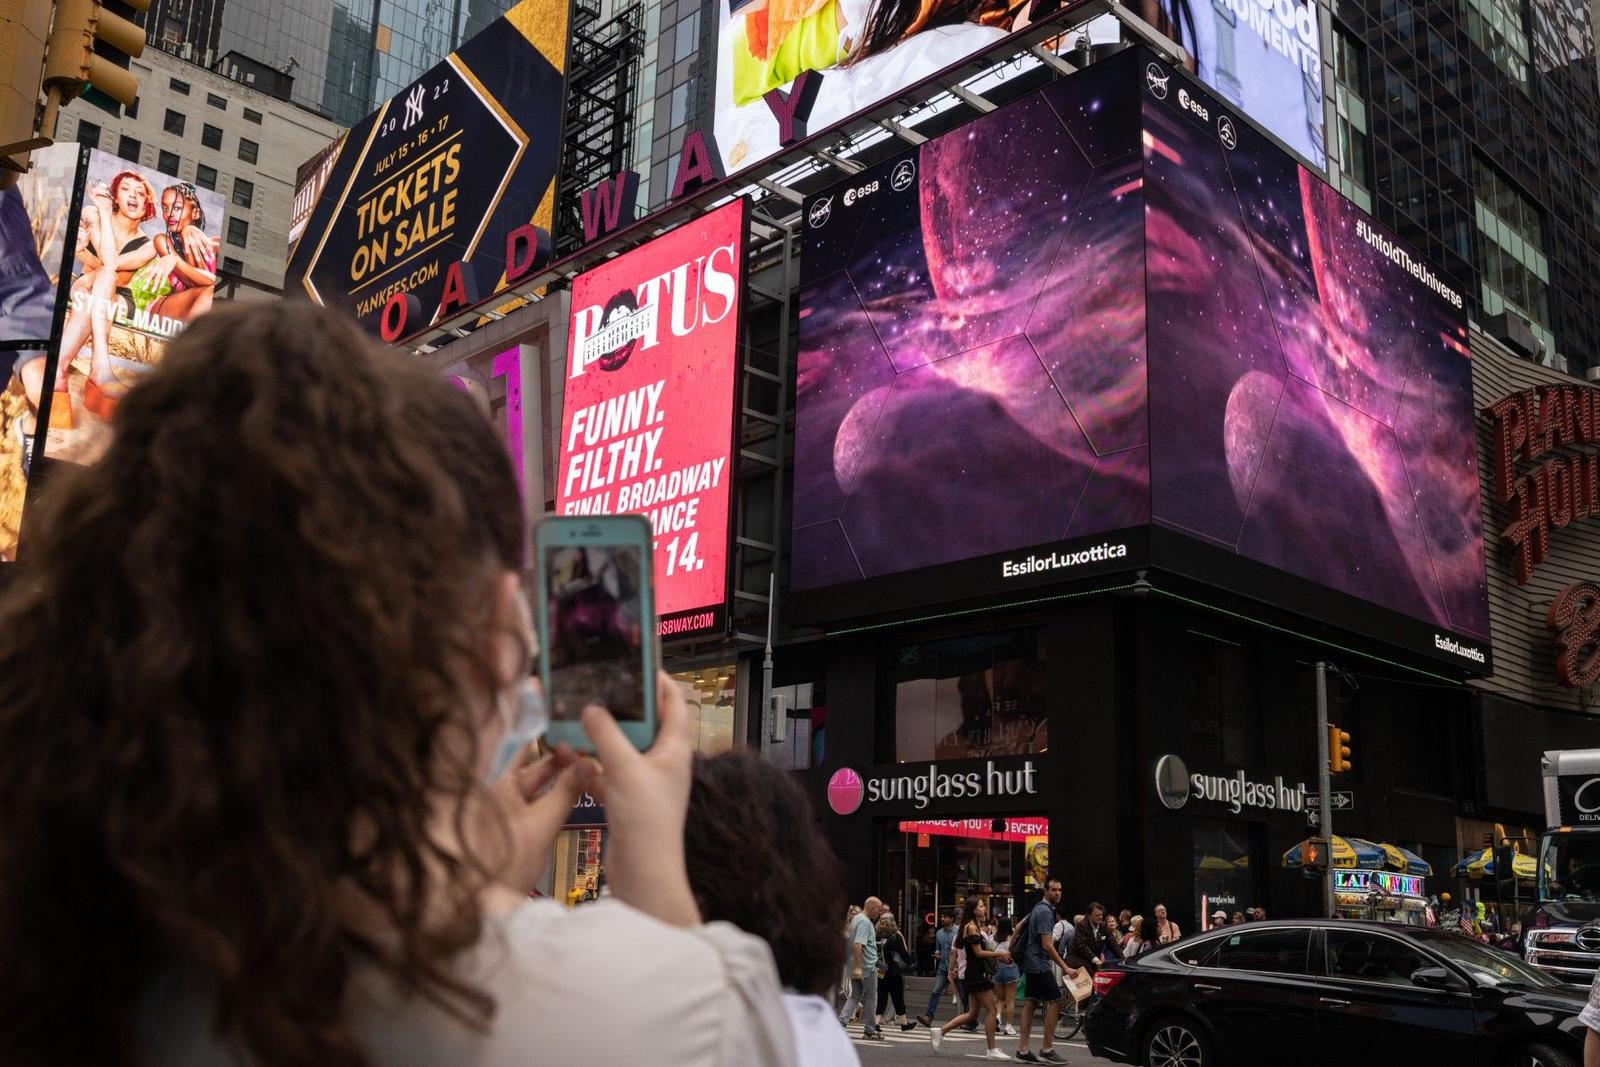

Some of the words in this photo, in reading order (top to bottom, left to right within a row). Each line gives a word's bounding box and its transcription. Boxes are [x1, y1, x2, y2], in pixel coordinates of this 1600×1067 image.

[1222, 0, 1320, 82] OMENT?
[382, 117, 396, 137] 20
[434, 80, 449, 100] 22
[373, 151, 397, 176] JULY
[399, 143, 408, 159] 15
[418, 129, 428, 146] 16
[438, 115, 449, 132] 17
[357, 143, 461, 240] TICKETS
[351, 231, 389, 281] ON
[394, 188, 458, 257] SALE
[1356, 219, 1463, 309] #UnfoldTheUniverse
[72, 291, 128, 323] STEVE
[131, 311, 190, 338] MADD
[567, 380, 665, 452] FUNNY.
[564, 427, 664, 498] FILTHY.
[616, 457, 726, 515] BROADWAY
[645, 498, 700, 537] ANCE
[666, 532, 704, 577] 14.
[1003, 543, 1127, 577] EssilorLuxottica
[1434, 634, 1485, 663] EssilorLuxottica
[868, 765, 981, 809] sunglass
[986, 761, 1038, 796] hut
[1191, 770, 1275, 814] sunglass
[963, 819, 982, 830] YOU
[1011, 823, 1043, 834] EVERY
